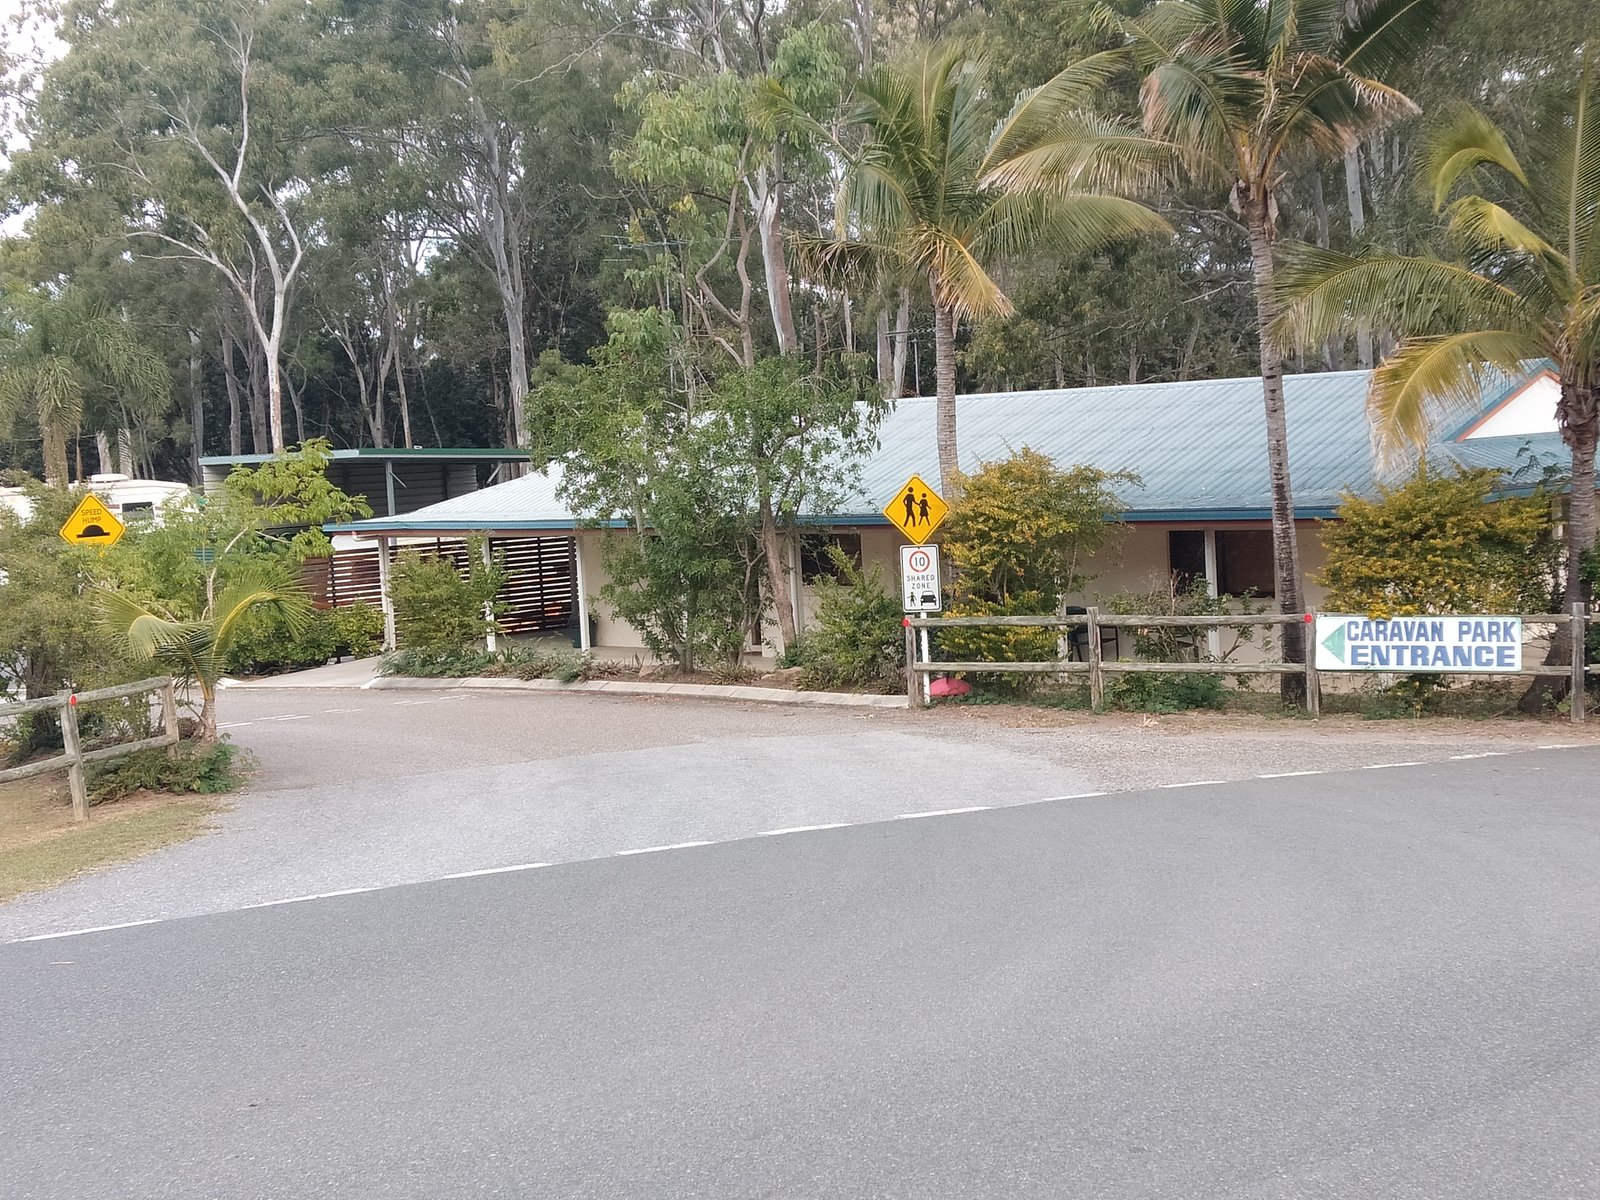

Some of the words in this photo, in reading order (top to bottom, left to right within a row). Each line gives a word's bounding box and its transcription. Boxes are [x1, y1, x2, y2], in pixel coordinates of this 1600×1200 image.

[81, 508, 102, 516] SPEED
[82, 516, 102, 524] HUMP
[914, 556, 926, 567] 10
[906, 574, 935, 582] SHARED
[911, 582, 931, 590] ZONE
[1346, 620, 1444, 642] CARAVAN
[1458, 621, 1517, 642] PARK
[1350, 645, 1516, 667] ENTRANCE
